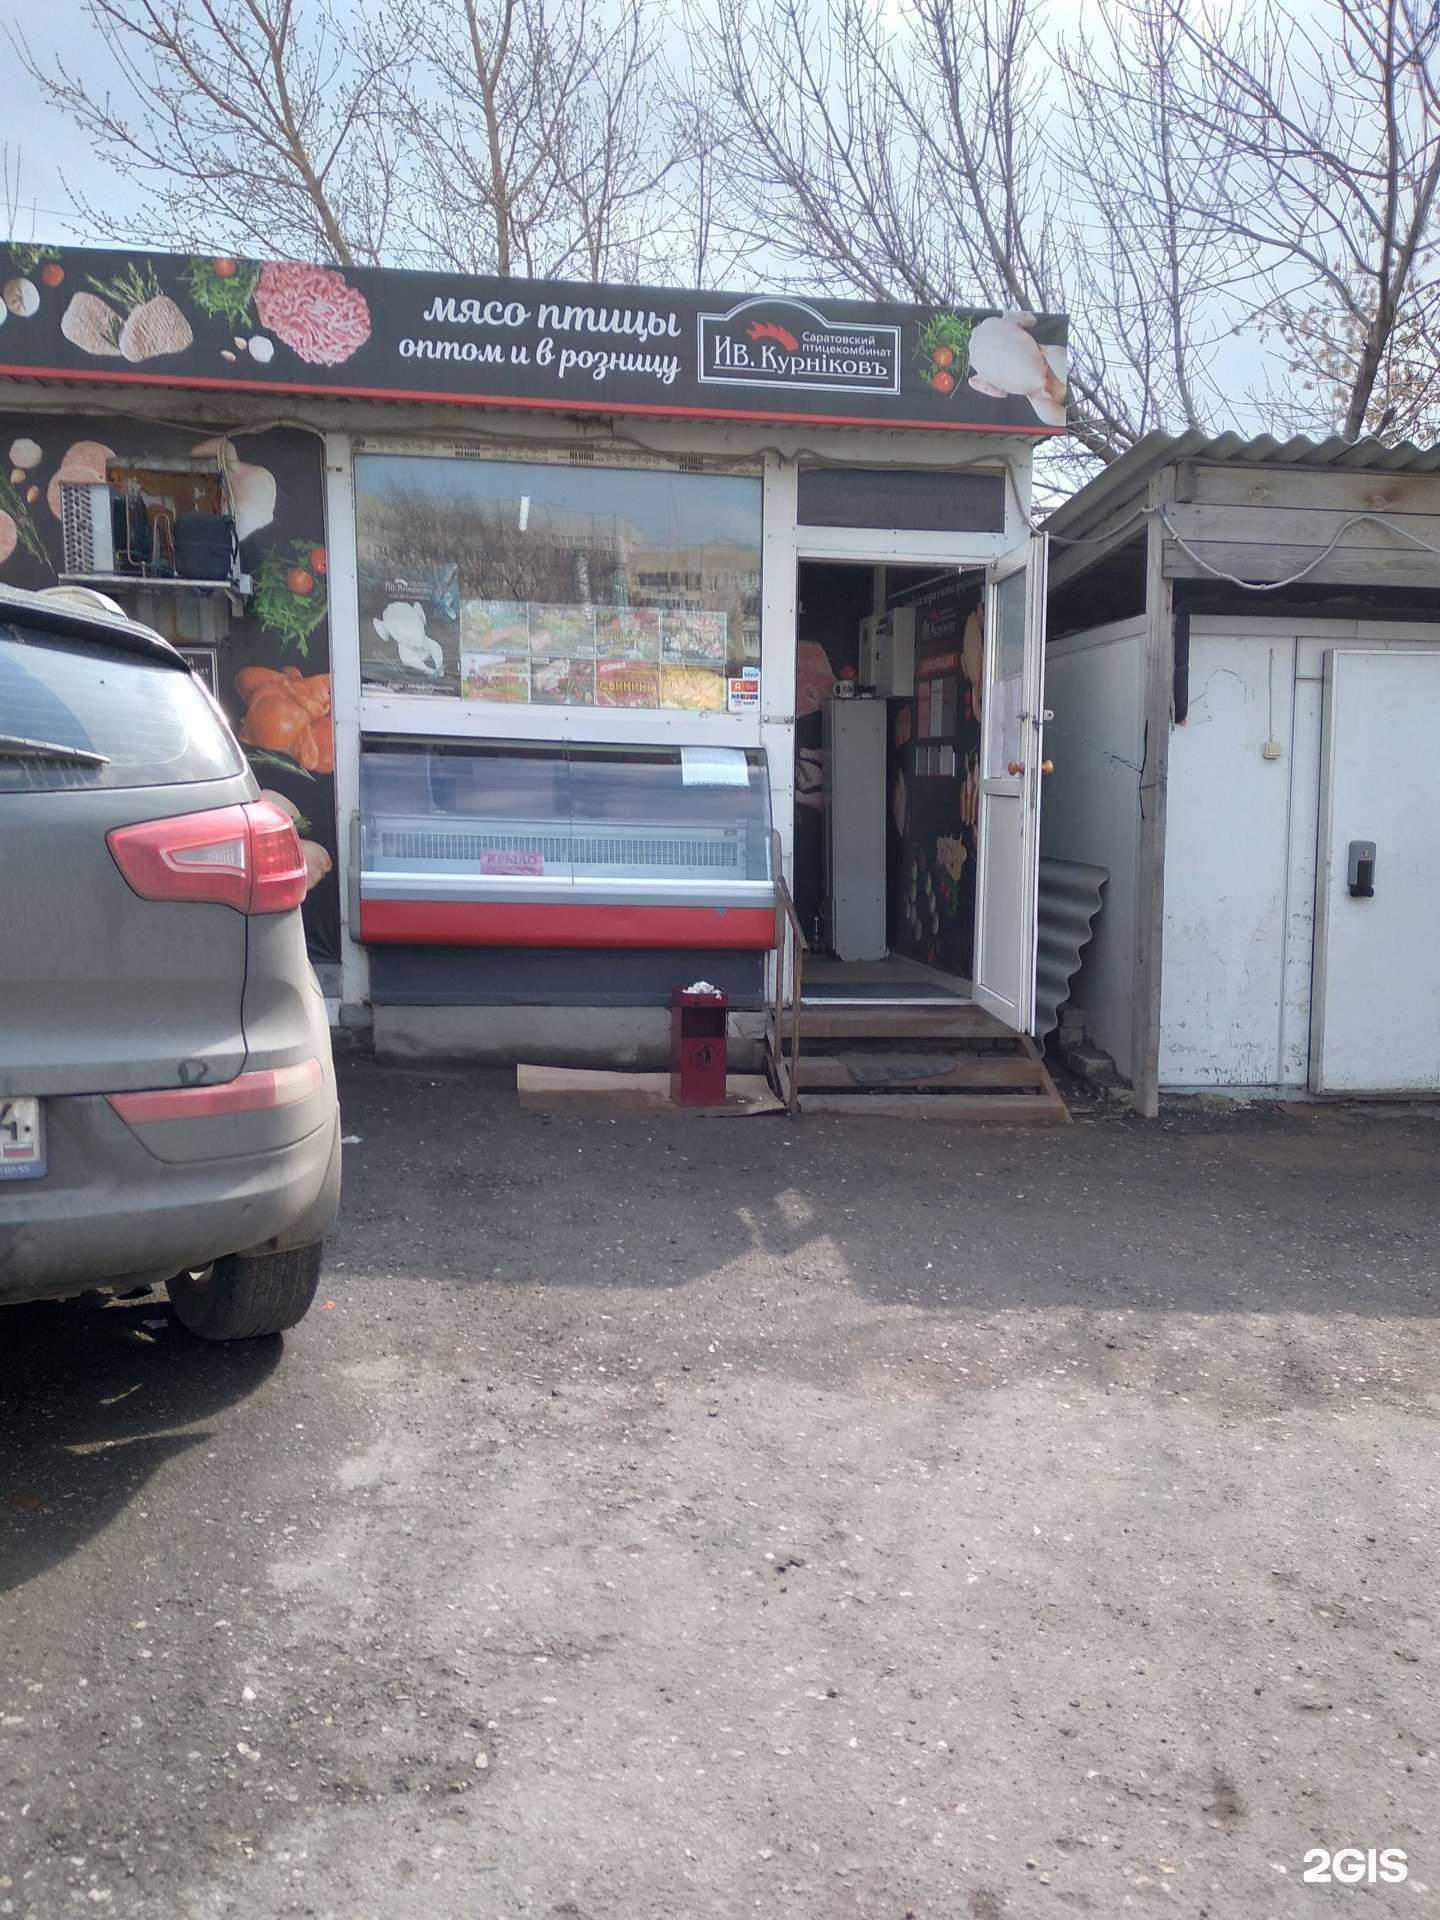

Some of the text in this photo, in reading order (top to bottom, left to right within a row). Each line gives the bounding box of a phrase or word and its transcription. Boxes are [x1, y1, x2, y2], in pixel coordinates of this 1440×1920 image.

[423, 297, 682, 342] мясо птицы
[713, 334, 755, 367] Ив.
[802, 331, 876, 345] Саратовский
[802, 344, 892, 357] птицекомбинат
[399, 337, 682, 385] оптом и в розницу
